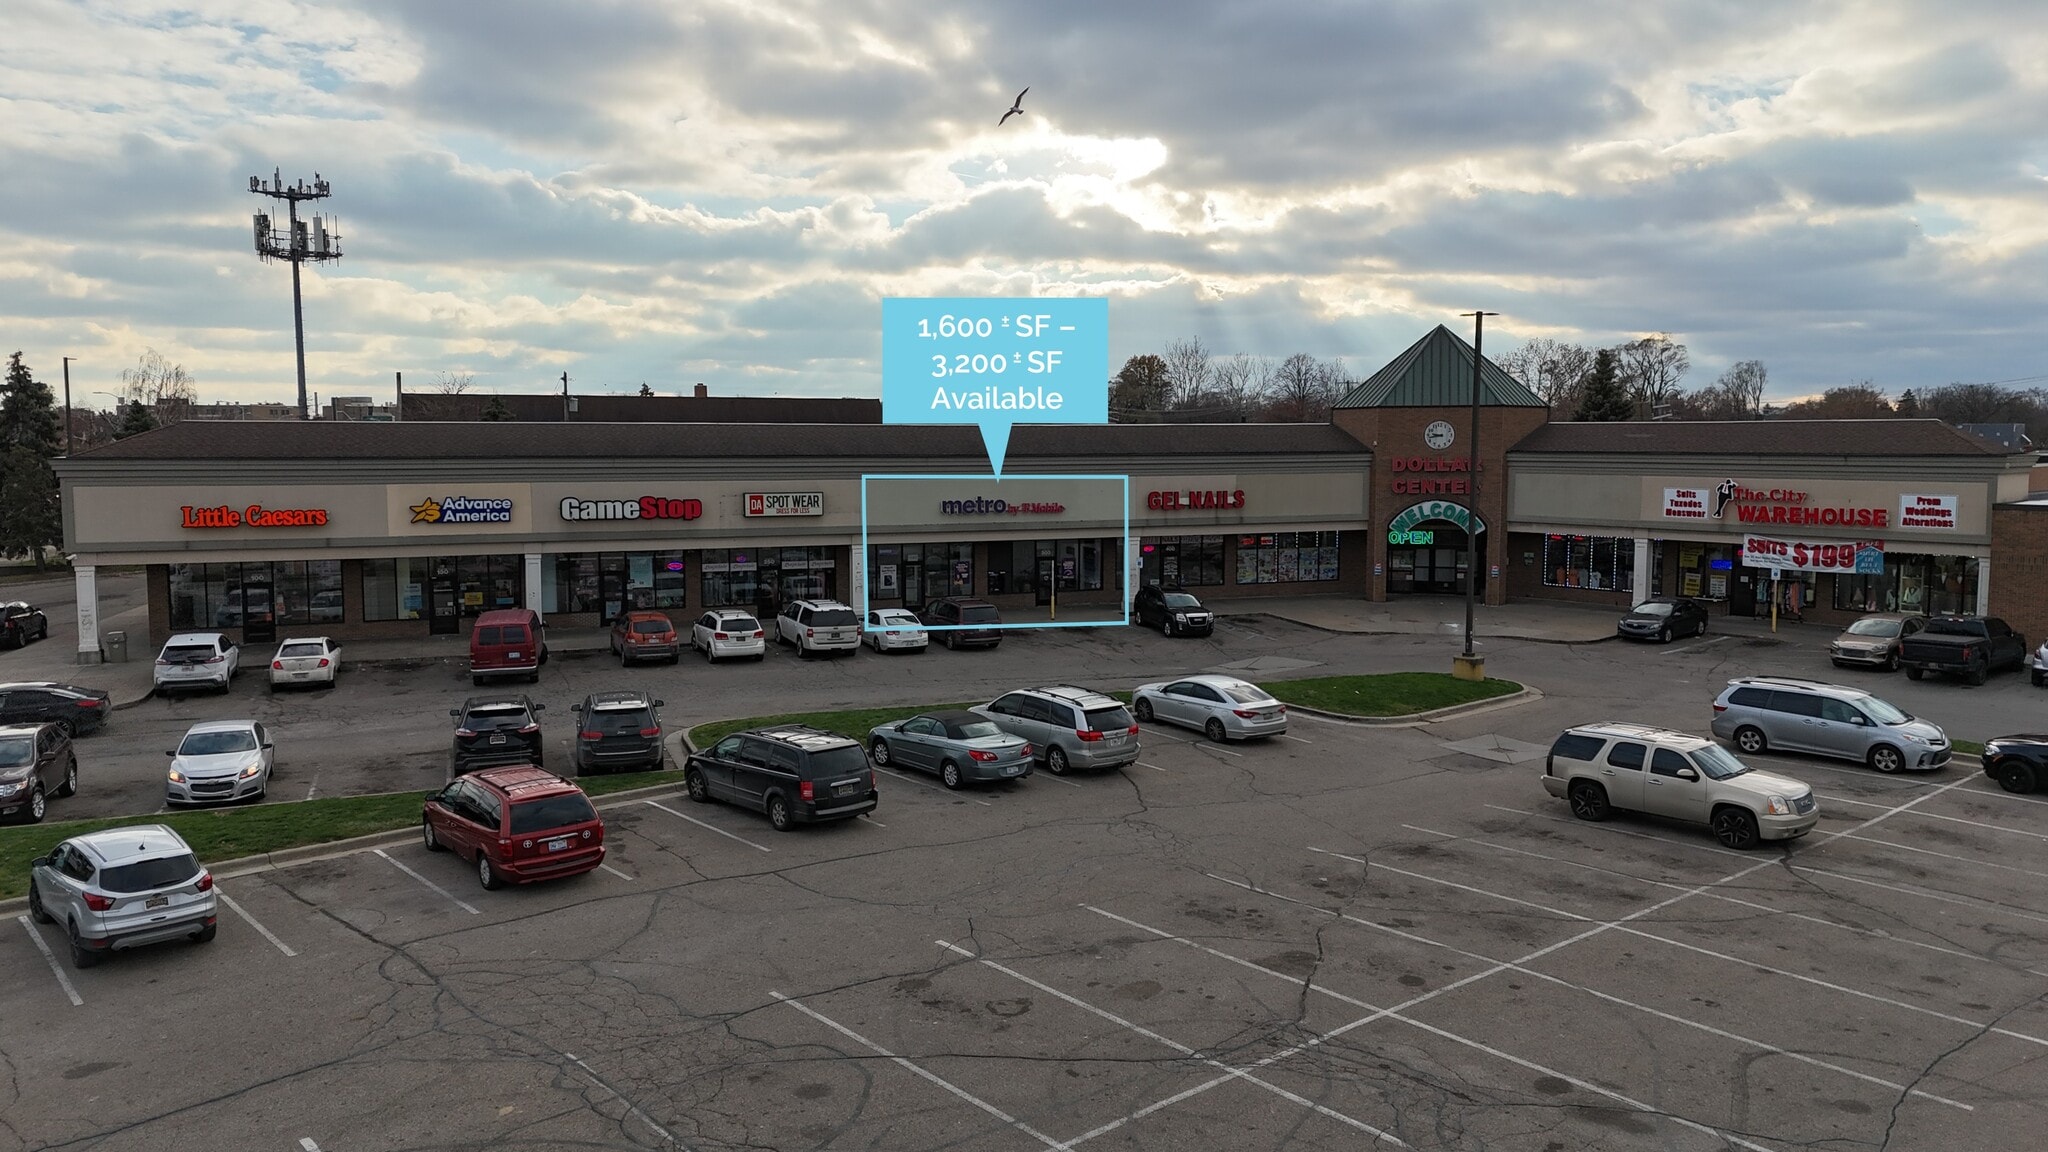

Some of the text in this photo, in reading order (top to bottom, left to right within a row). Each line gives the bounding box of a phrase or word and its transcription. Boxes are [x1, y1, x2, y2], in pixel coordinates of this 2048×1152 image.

[766, 494, 820, 509] SPOT WEAR
[1147, 489, 1246, 511] GEL NAILS
[1675, 489, 1697, 499] Suits
[1733, 487, 1807, 505] The City
[1916, 496, 1942, 506] Prom
[443, 497, 512, 510] Advance
[560, 496, 703, 521] GameStop
[751, 499, 764, 511] DA
[941, 495, 1007, 515] metro
[180, 505, 328, 528] Little Caesars
[443, 509, 511, 522] America
[1737, 504, 1888, 528] WAREHOUSE
[1905, 506, 1953, 518] Weddings
[1901, 517, 1954, 528] Alterations
[1388, 530, 1434, 545] OPEN
[1747, 537, 1789, 556] SUITS
[1791, 541, 1855, 568] $199
